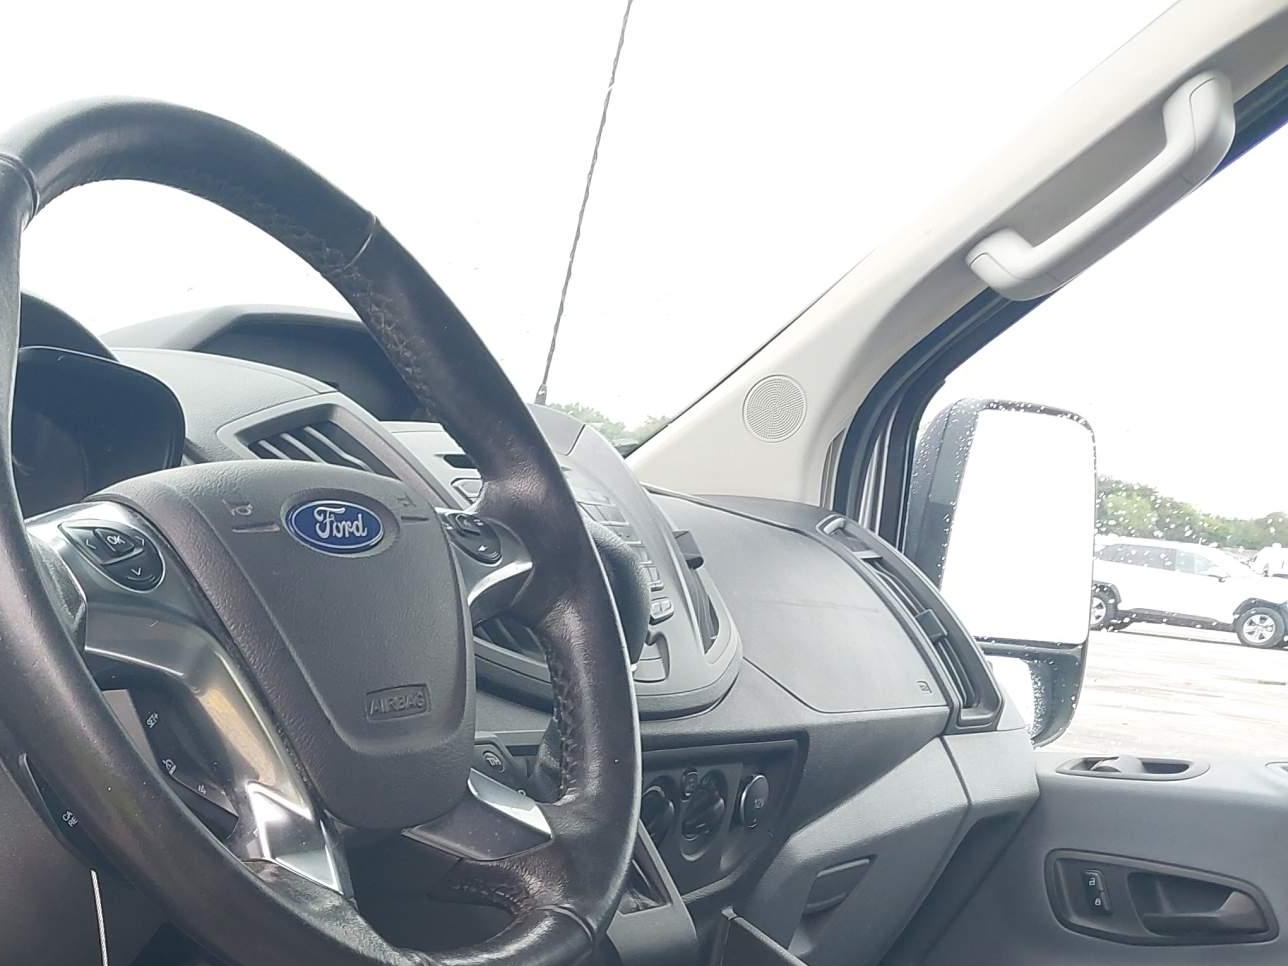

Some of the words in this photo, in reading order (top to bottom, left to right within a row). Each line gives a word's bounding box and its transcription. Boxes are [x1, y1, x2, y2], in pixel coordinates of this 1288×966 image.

[314, 506, 368, 539] Ford
[107, 535, 126, 545] OK
[367, 691, 426, 714] AIRBAG
[62, 810, 73, 822] CA
[67, 816, 79, 828] RE
